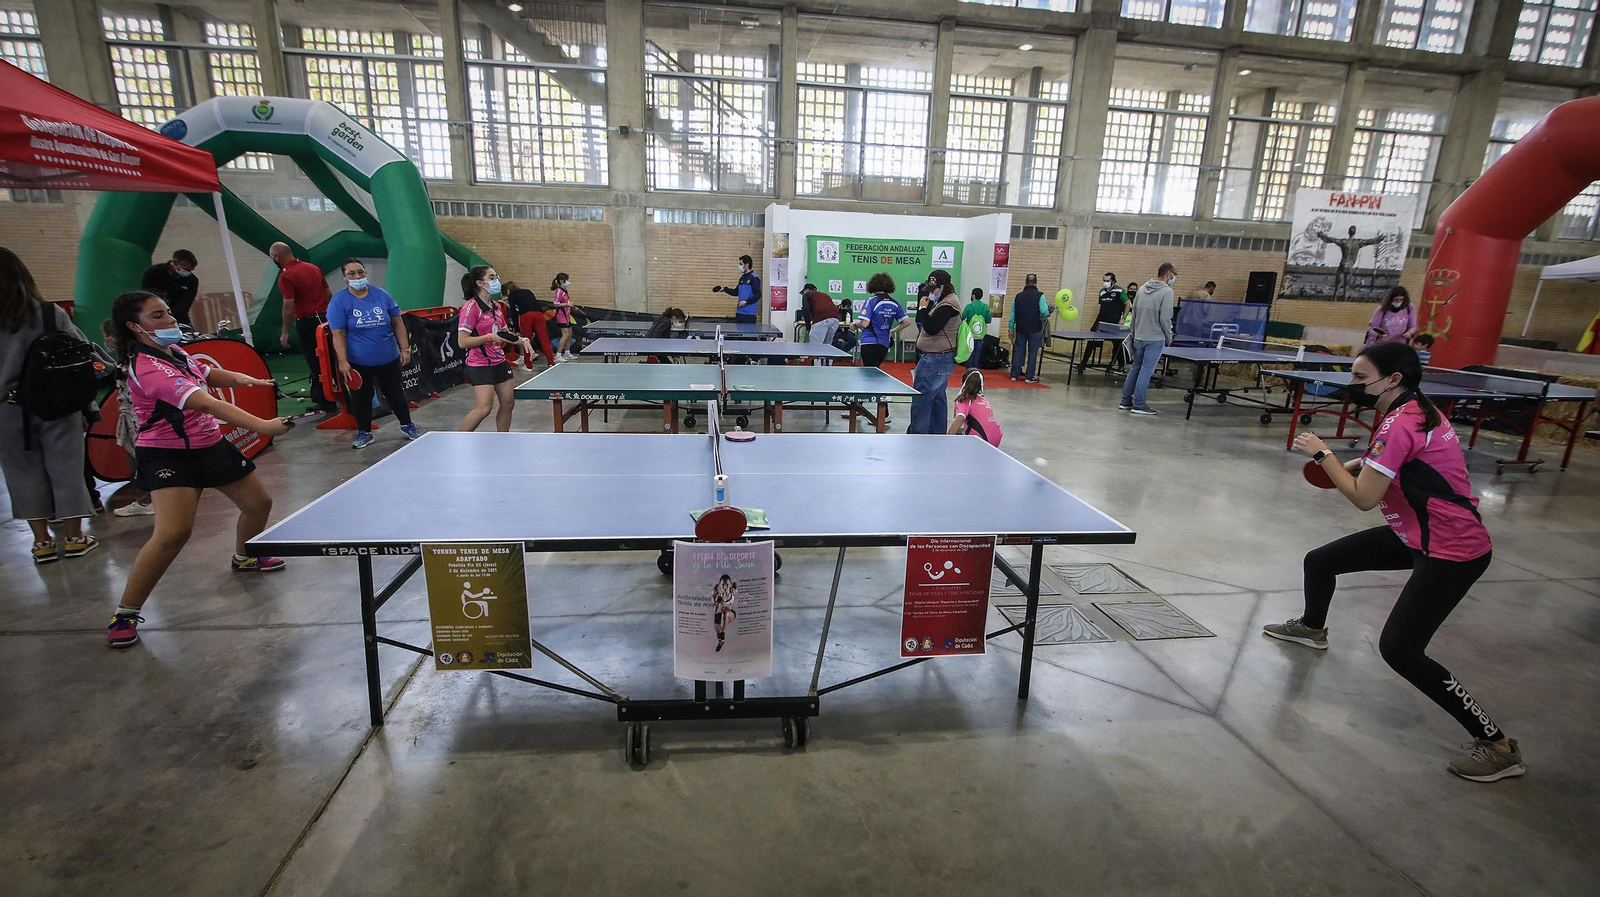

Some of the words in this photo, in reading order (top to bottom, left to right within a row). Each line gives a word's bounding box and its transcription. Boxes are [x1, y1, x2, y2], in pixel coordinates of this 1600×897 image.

[331, 127, 364, 151] garden
[846, 243, 889, 252] FEDERACIÓN
[890, 245, 925, 253] ANDALUZA
[851, 255, 878, 264] TENIS
[880, 256, 893, 265] DE
[895, 256, 921, 265] MESA
[328, 547, 378, 555] SPACE
[696, 552, 715, 560] FERIA
[729, 551, 756, 560] DEPORTE
[1443, 674, 1498, 737] Reebok
